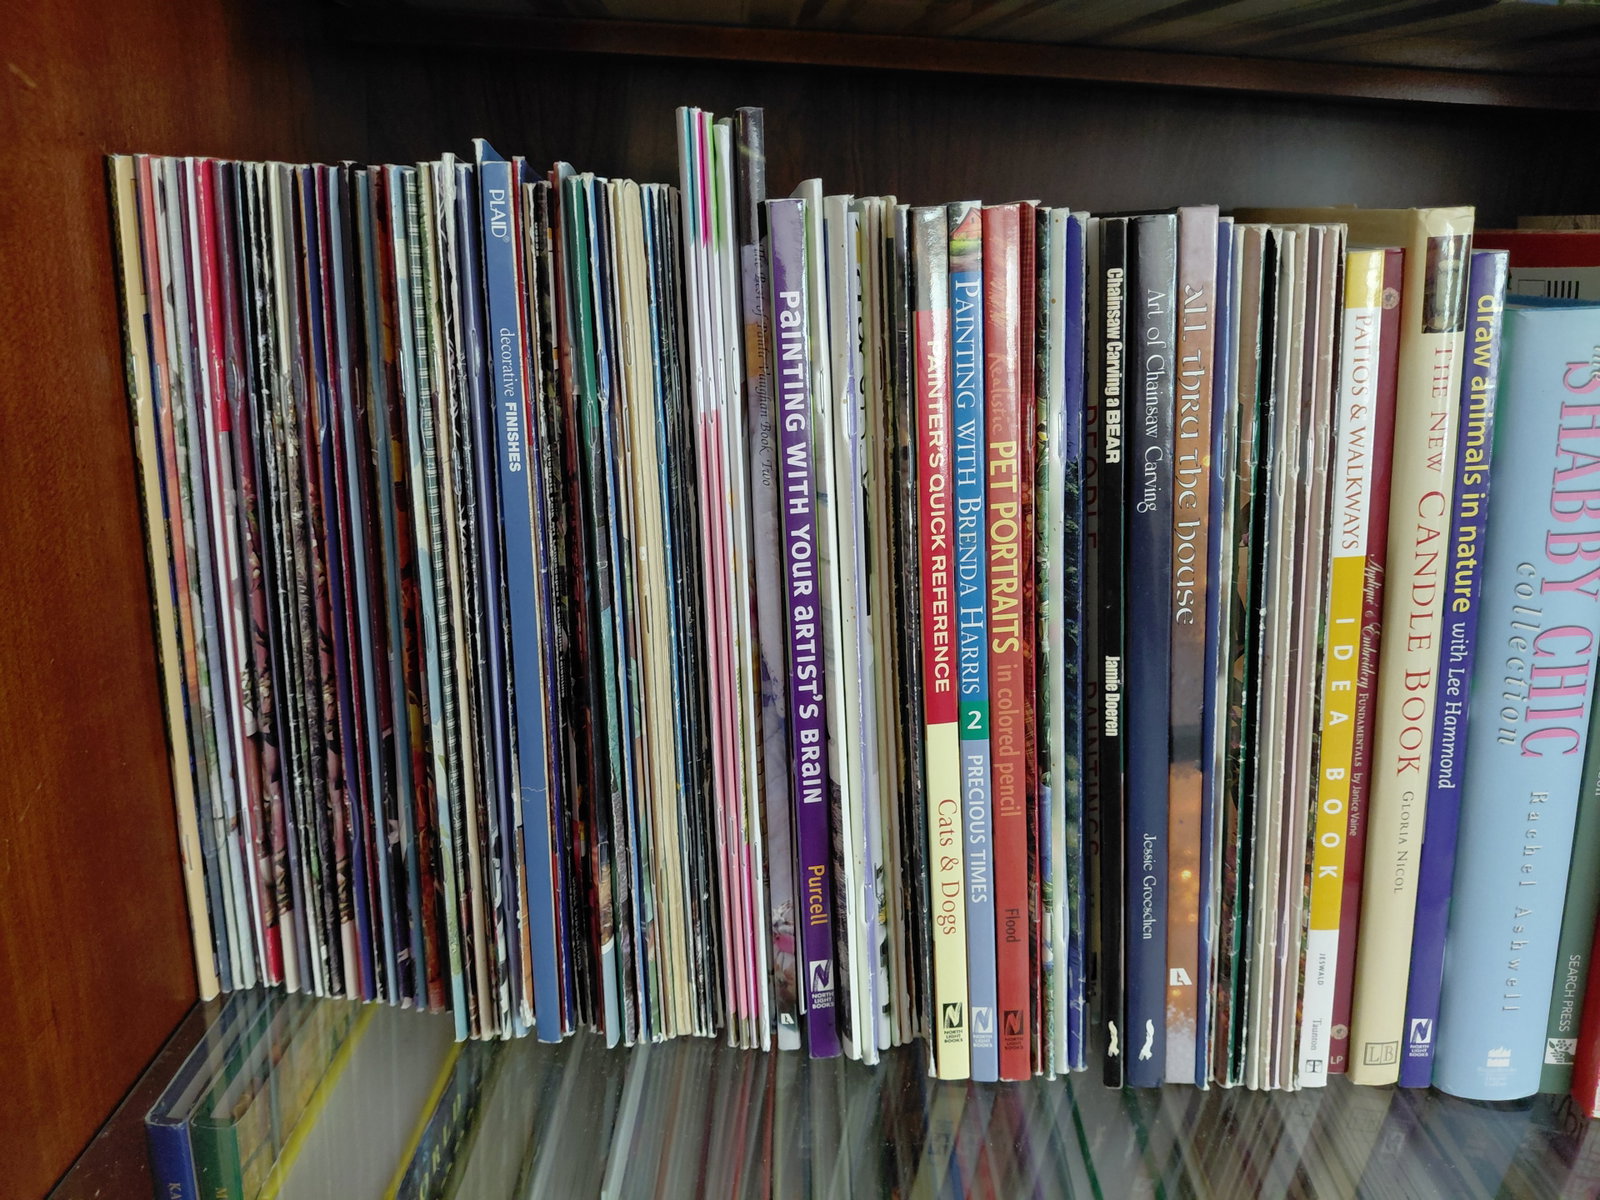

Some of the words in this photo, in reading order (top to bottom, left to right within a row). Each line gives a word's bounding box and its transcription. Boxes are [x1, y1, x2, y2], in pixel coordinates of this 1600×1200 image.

[752, 306, 768, 318] of
[754, 273, 766, 300] Best
[1106, 268, 1123, 339] Chainsaw
[1147, 289, 1165, 320] Art
[756, 323, 768, 359] Paula
[955, 280, 981, 409] PAINTING
[1146, 327, 1167, 346] of
[1350, 314, 1373, 396] PATIOS
[1471, 294, 1497, 366] draw
[499, 328, 516, 396] decorative
[1105, 341, 1122, 396] Carving
[1431, 343, 1452, 399] THE
[754, 365, 770, 417] Vaughan
[926, 340, 945, 468] PAINTER'S
[989, 354, 1016, 435] Realistic
[1106, 398, 1119, 408] a
[1144, 355, 1165, 439] Chainsaw
[1350, 404, 1368, 420] &
[505, 402, 520, 472] FINISHES
[760, 422, 771, 455] Book
[958, 418, 977, 485] WITH
[1105, 410, 1121, 463] BEAR
[1426, 411, 1449, 473] NEW
[1463, 377, 1495, 485] animals
[761, 459, 772, 486] Two
[786, 444, 808, 515] WITH
[990, 441, 1017, 493] PET
[1137, 446, 1162, 513] Carving
[1341, 425, 1367, 549] WALKWAYS
[1540, 361, 1600, 602] SHABBY
[929, 474, 946, 549] QUICK
[1460, 493, 1485, 518] in
[790, 523, 812, 597] YOUR
[958, 498, 982, 597] BRENDA
[1407, 491, 1446, 652] CANDLE
[1452, 525, 1480, 613] nature
[990, 503, 1020, 653] PORTRAITS
[931, 556, 950, 692] REFERENCE
[959, 607, 984, 695] HARRIS
[1449, 622, 1469, 662] with
[997, 665, 1017, 681] in
[1105, 656, 1120, 691] Jamie
[1357, 622, 1380, 688] Embroidery
[1447, 668, 1465, 696] Lee
[1498, 563, 1543, 747] collection
[1105, 693, 1120, 736] Doeren
[1521, 626, 1594, 758] CHIC
[968, 710, 982, 730] 2
[998, 689, 1019, 757] colored
[1354, 693, 1369, 767] FUNDAMENTALS
[1396, 668, 1431, 776] BOOK
[1438, 701, 1462, 789] Hammond
[967, 755, 987, 843] PRECIOUS
[994, 763, 1020, 817] pencil
[1350, 786, 1363, 812] Janice
[1351, 773, 1363, 784] by
[937, 799, 958, 847] Cats
[1349, 813, 1360, 836] Vaine
[1398, 790, 1415, 845] GLORIA
[1519, 791, 1549, 887] Rachel
[940, 856, 958, 873] &
[970, 850, 987, 903] TIMES
[1142, 834, 1157, 872] Jessie
[1394, 851, 1409, 894] NICOL
[808, 865, 827, 926] Purcell
[937, 881, 960, 935] Dogs
[1142, 876, 1157, 939] Groeschen
[1005, 909, 1020, 943] Flood
[1317, 953, 1326, 986] JESWALD
[1503, 906, 1532, 1012] Ashwell
[1564, 955, 1581, 998] SEARCH
[812, 1001, 834, 1009] BOOKS
[1559, 1000, 1577, 1032] PRESS
[1310, 1018, 1322, 1051] Taunton
[1330, 1056, 1343, 1064] LP
